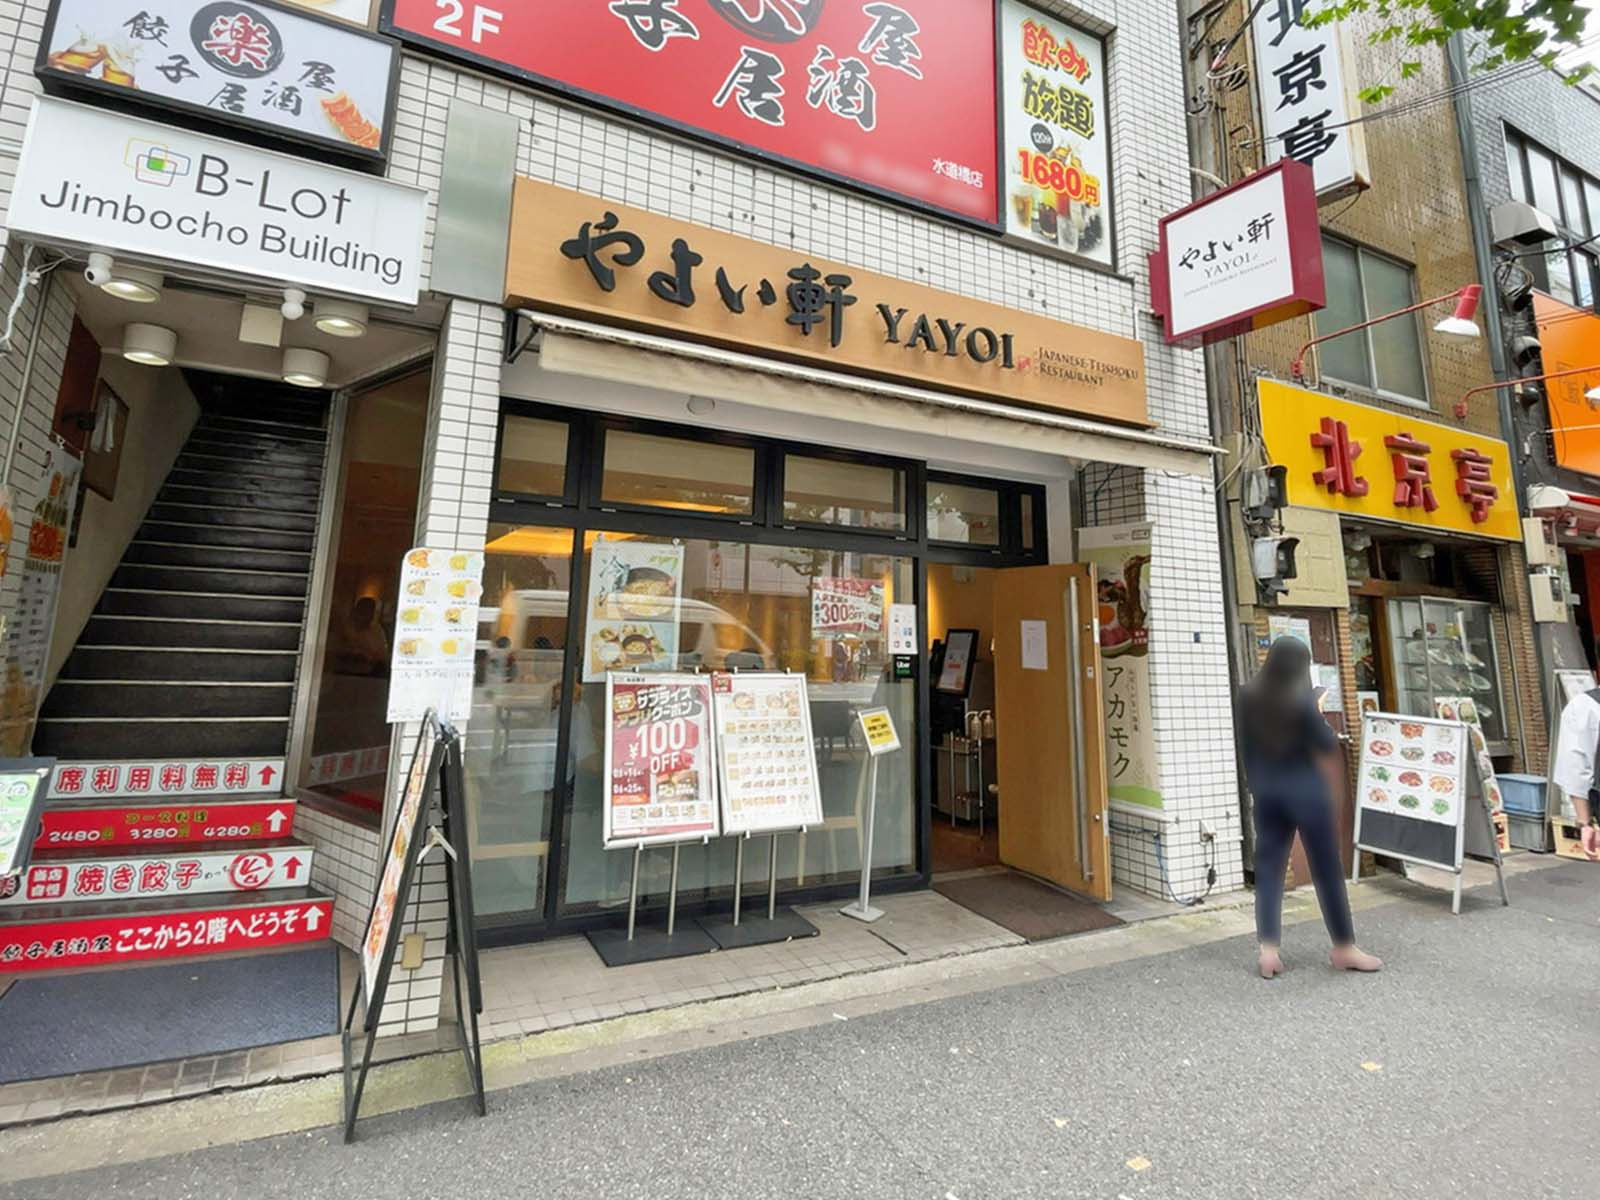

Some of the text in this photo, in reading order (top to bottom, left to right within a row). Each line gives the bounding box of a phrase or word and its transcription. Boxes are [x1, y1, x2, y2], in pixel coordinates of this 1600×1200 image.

[200, 13, 271, 70] 楽
[433, 2, 504, 44] 2F
[1021, 18, 1093, 84] 飲み
[1023, 70, 1095, 139] 放題
[194, 153, 352, 225] B-Lot
[40, 180, 403, 285] Jimbocho Building
[1178, 212, 1275, 271] やよい軒
[560, 211, 858, 348] やよい軒
[1203, 252, 1250, 279] YAYOI
[876, 303, 1015, 369] YAYOI
[1310, 416, 1498, 524] 北京亭
[820, 602, 848, 624] 300
[1106, 665, 1131, 779] アカモク
[56, 763, 250, 794] 席利用料無料
[650, 752, 681, 774] OFF
[75, 861, 202, 896] 焼き餃子
[115, 908, 301, 953] ここから2階へどうぞ
